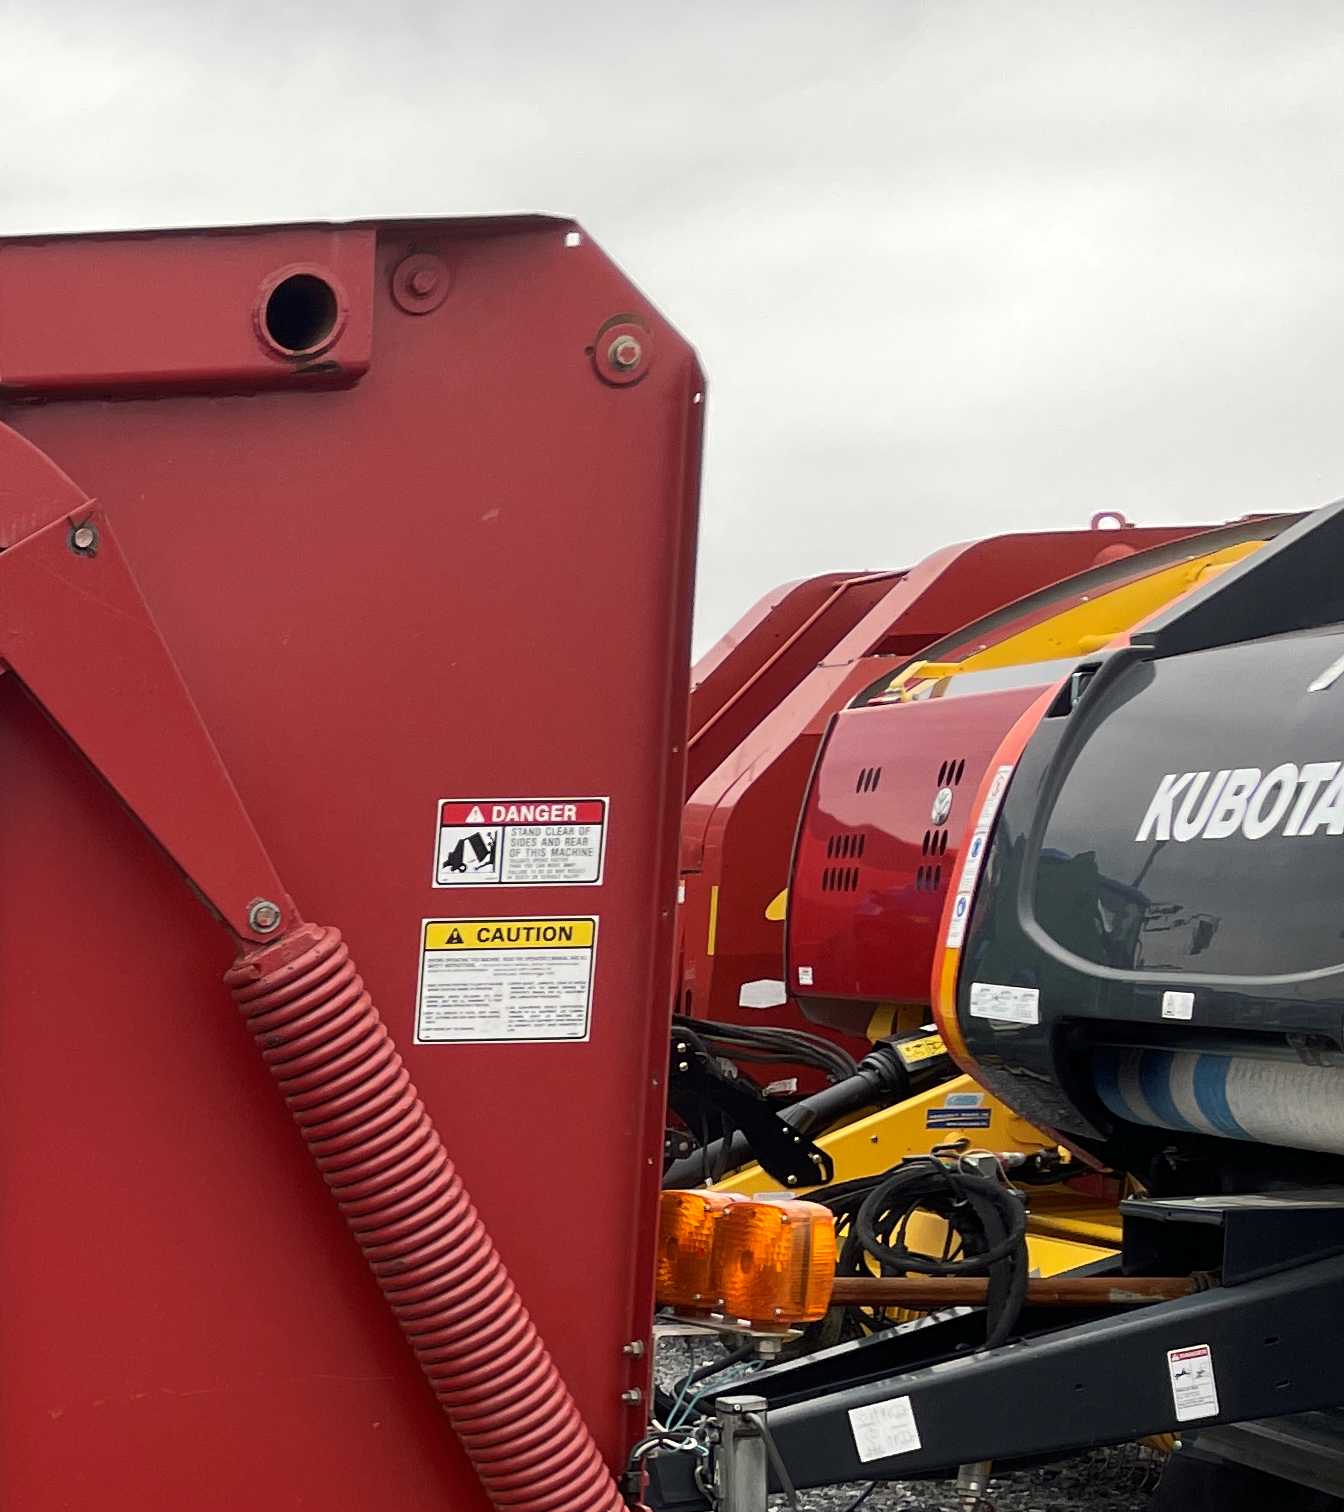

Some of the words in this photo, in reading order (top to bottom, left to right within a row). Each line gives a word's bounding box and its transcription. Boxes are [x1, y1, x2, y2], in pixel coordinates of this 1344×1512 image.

[1135, 761, 1344, 842] KUBOTA
[491, 804, 577, 822] DANGER
[511, 827, 542, 837] STAND
[545, 827, 574, 836] CLEAR
[578, 827, 592, 836] OF
[510, 838, 537, 847] SIDES
[541, 838, 560, 847] AND
[564, 837, 589, 846] REAR
[509, 849, 521, 857] OF
[526, 848, 546, 857] THIS
[550, 848, 593, 857] MACHINE
[476, 926, 573, 943] CAUTION
